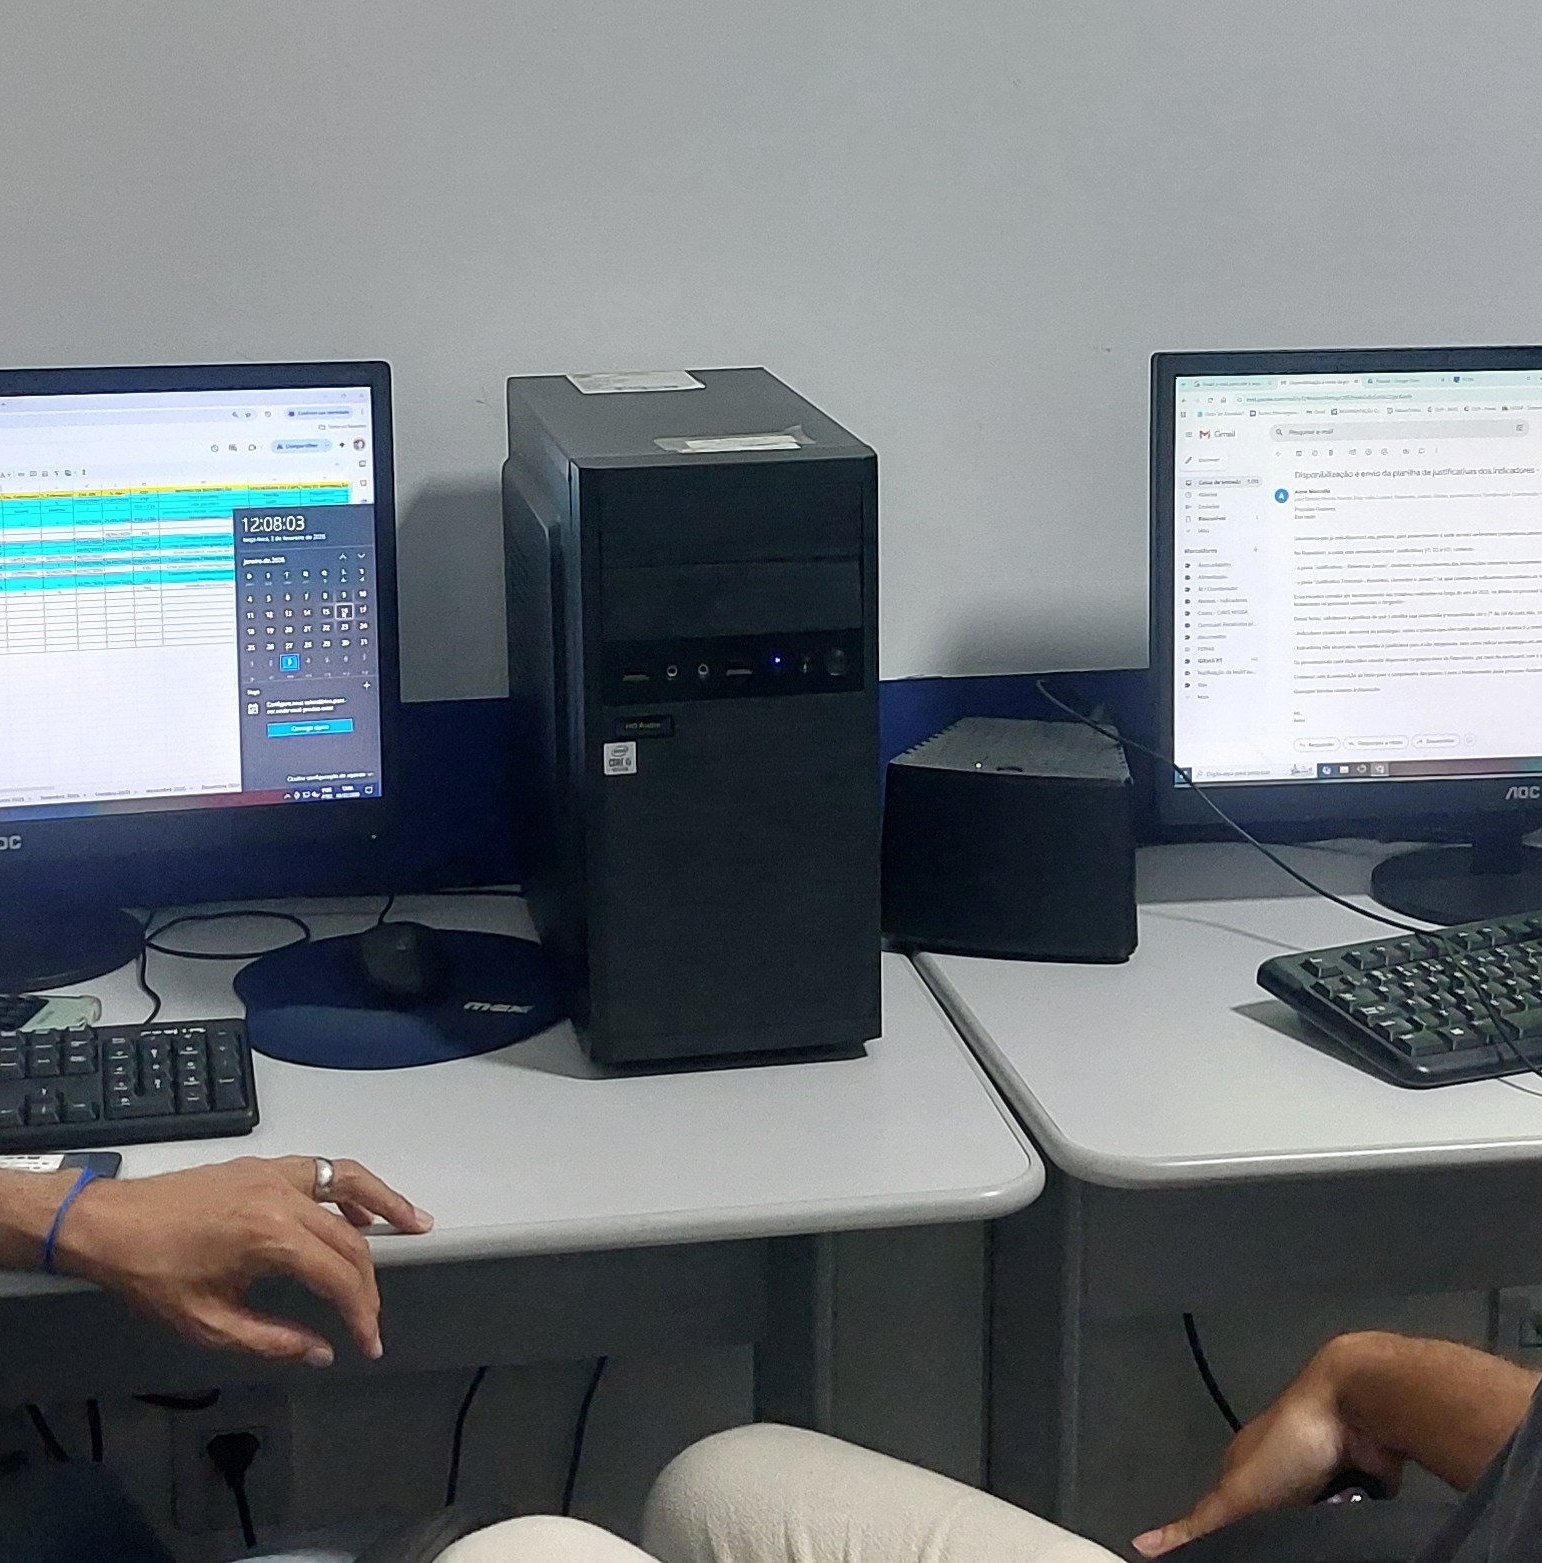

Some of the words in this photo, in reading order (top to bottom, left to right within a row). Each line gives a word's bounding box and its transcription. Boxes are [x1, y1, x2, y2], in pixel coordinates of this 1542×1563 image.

[1214, 430, 1236, 439] Gmail
[1295, 471, 1353, 480] Disponibilização
[1392, 469, 1420, 478] planilha
[242, 515, 305, 532] 12:08:03
[359, 590, 367, 598] 10
[1505, 785, 1541, 800] AOC
